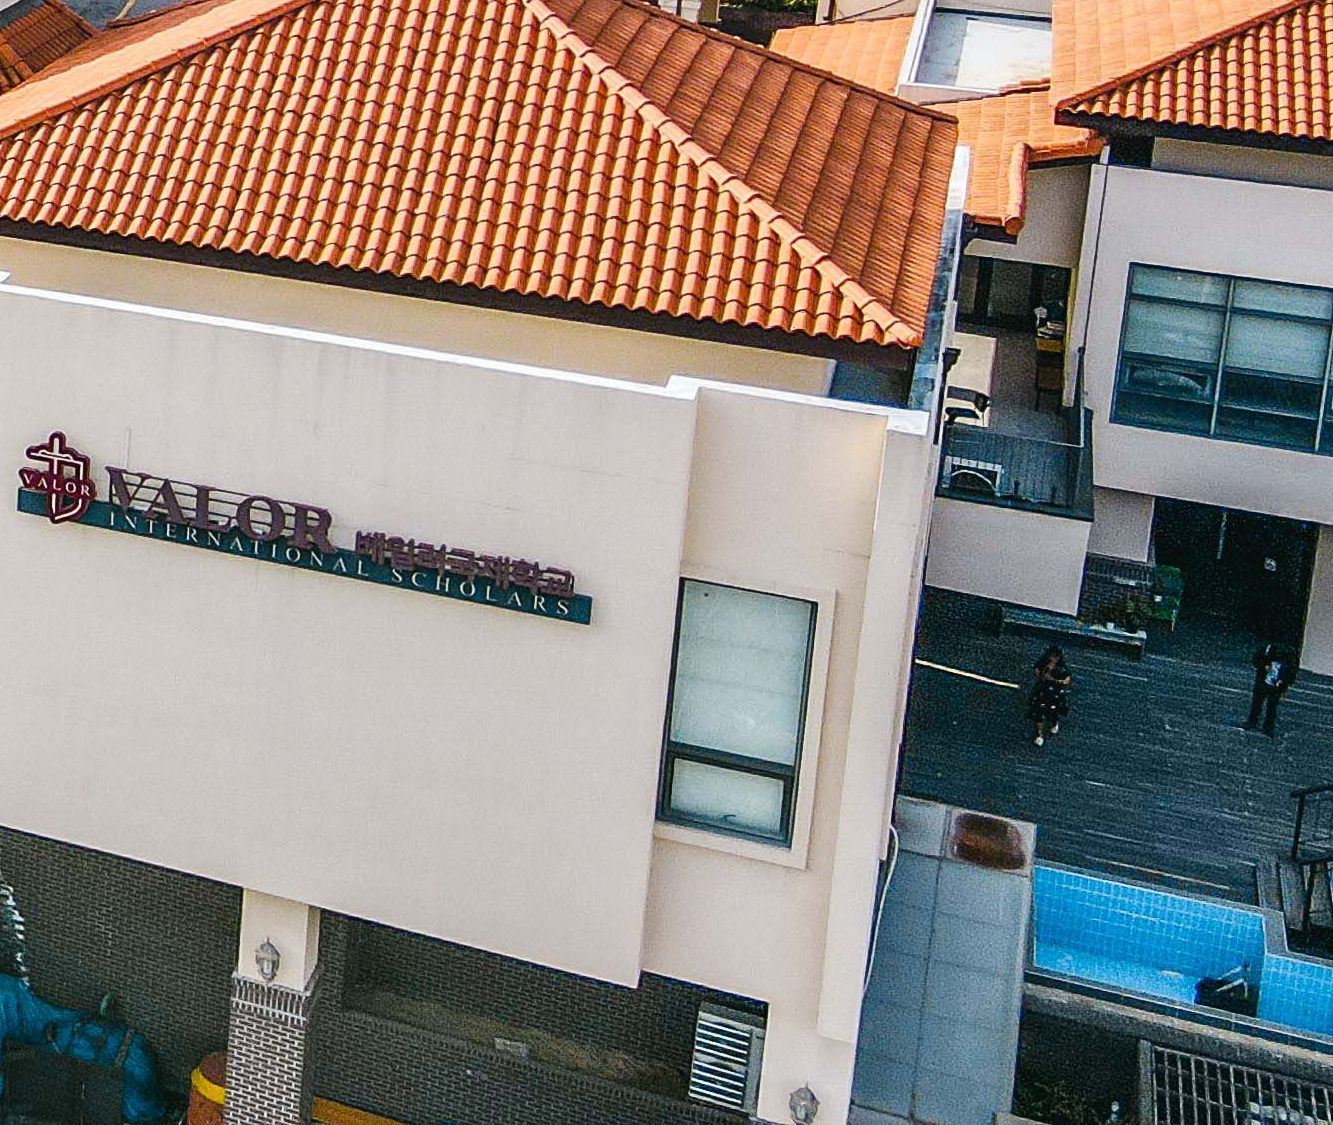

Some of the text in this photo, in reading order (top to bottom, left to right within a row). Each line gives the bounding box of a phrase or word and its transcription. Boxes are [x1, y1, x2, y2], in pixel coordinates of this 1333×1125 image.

[22, 473, 91, 497] VALOR
[106, 466, 336, 554] VALOR
[109, 511, 572, 616] INTERNATIONAL SCHOLARS
